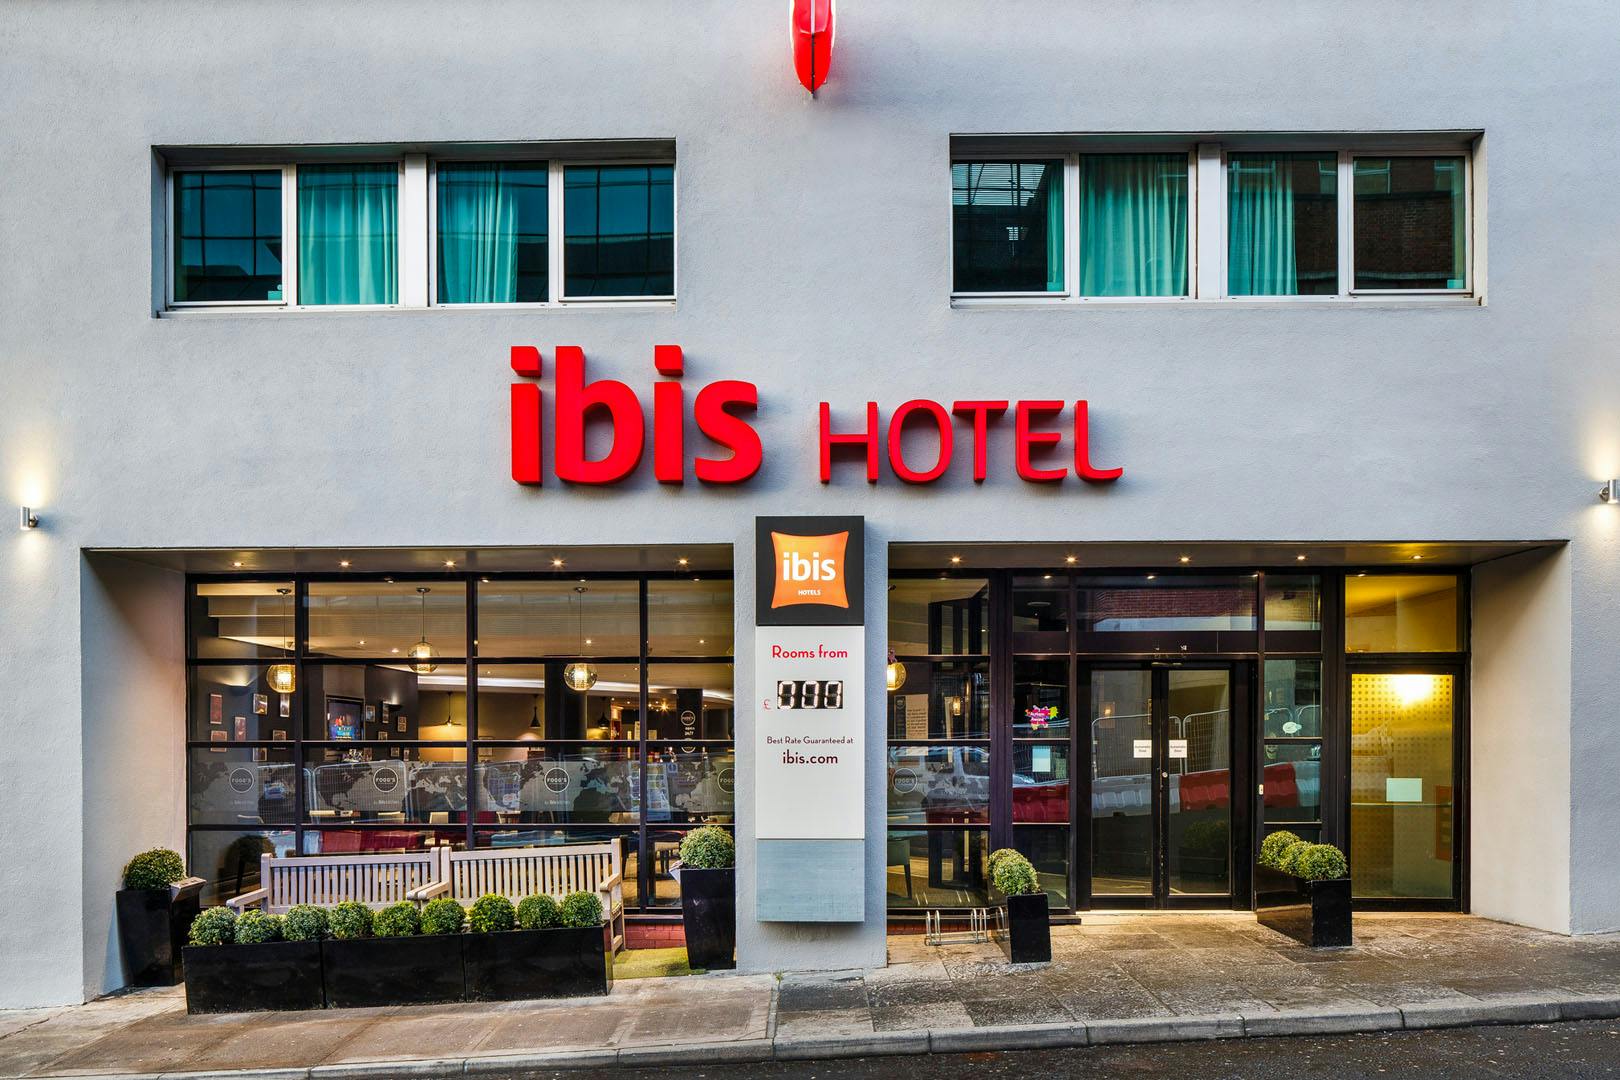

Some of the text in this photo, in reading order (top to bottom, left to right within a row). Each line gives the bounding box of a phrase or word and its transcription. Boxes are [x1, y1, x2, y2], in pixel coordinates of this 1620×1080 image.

[511, 345, 1123, 485] ibis HOTEL
[783, 551, 836, 581] ibis
[772, 644, 848, 658] Rooms from
[766, 736, 853, 744] Best Rate Guaranteed at
[782, 749, 838, 764] ibis.com
